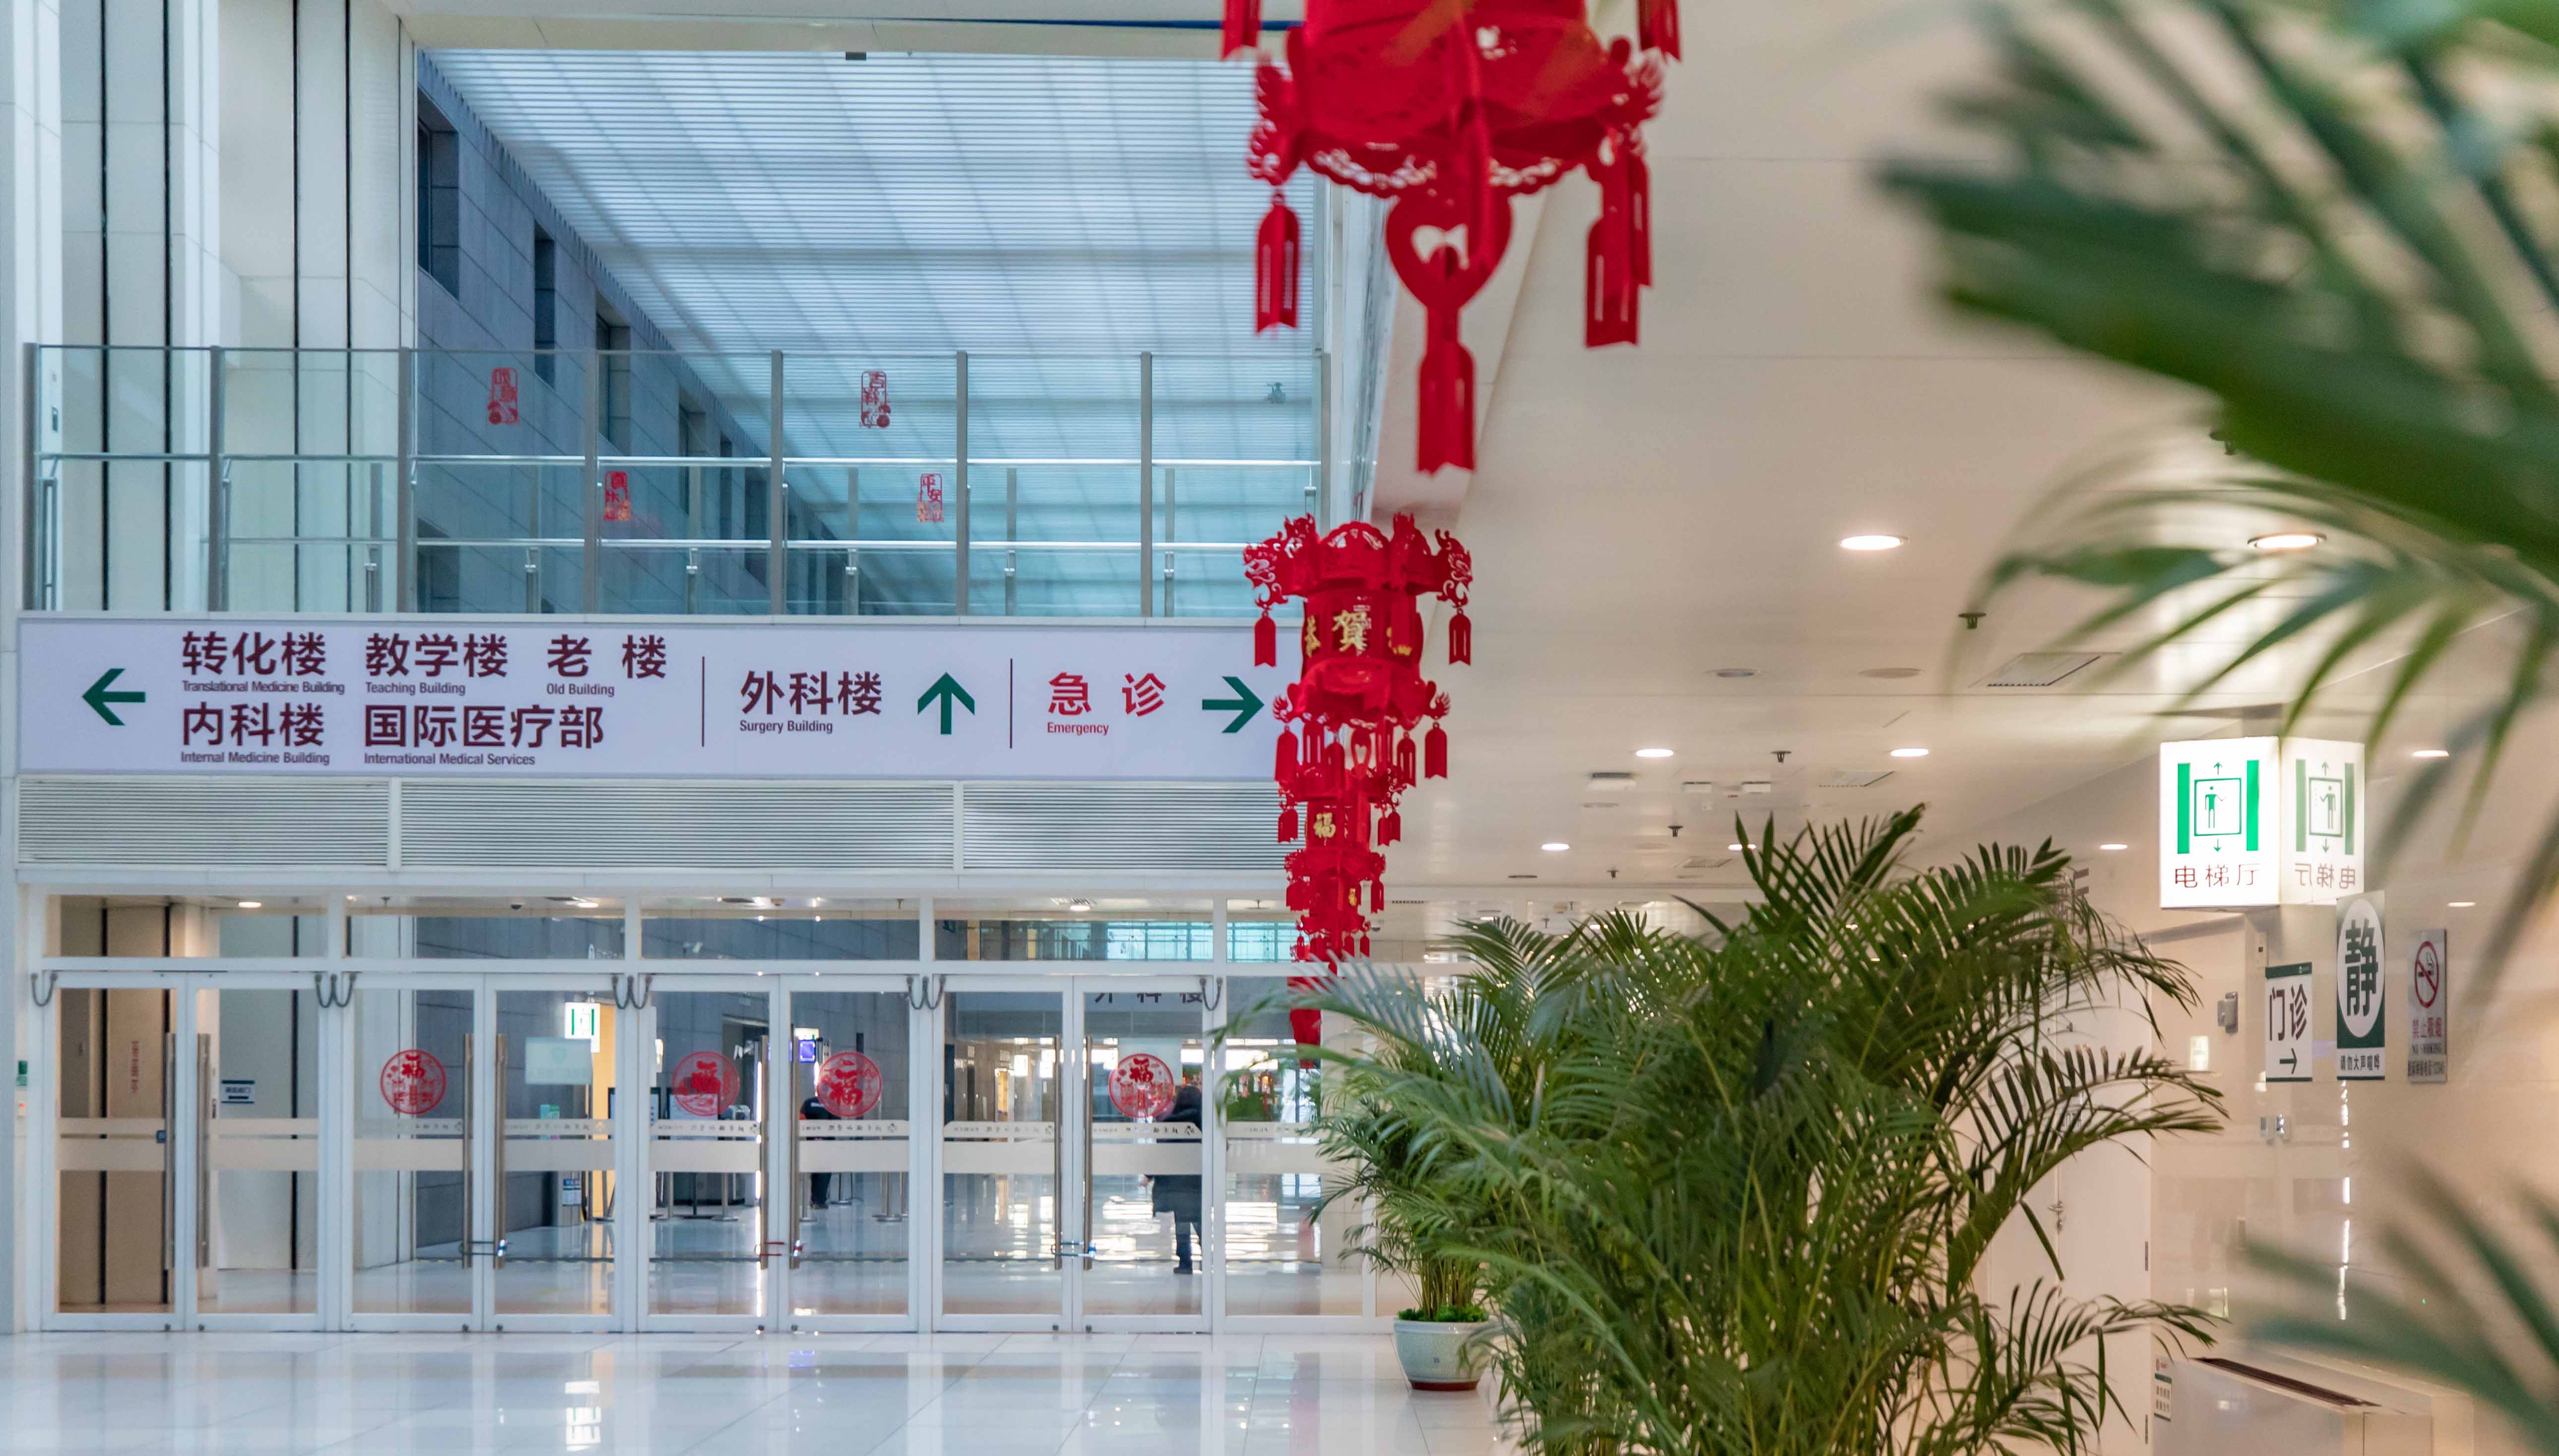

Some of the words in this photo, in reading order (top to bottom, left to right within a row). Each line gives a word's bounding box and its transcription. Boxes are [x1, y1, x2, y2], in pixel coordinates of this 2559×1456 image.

[182, 631, 326, 676] 转化楼
[366, 633, 508, 677] 教学楼
[547, 634, 666, 678] 老楼
[182, 680, 248, 692] Translational
[252, 681, 299, 692] Medicine
[302, 681, 345, 695] Building
[365, 681, 415, 696] Teaching
[419, 682, 465, 696] Building
[547, 683, 565, 695] Old
[569, 683, 615, 697] Building
[741, 671, 881, 715] 外科楼
[1048, 672, 1166, 717] 急诊
[183, 701, 324, 746] 内科楼
[365, 704, 603, 749] 国际医疗部
[740, 720, 783, 734] Surgery
[787, 720, 833, 734] Building
[1047, 722, 1109, 735] Emergency
[181, 751, 225, 763] Internal
[228, 751, 280, 763] Medicine
[283, 752, 330, 766] Building
[364, 753, 436, 764] International
[439, 753, 483, 765] Medical
[487, 753, 535, 765] Services
[2175, 864, 2261, 888] 电梯厅
[2345, 918, 2379, 1017] 静
[2269, 984, 2308, 1041] 门诊
[829, 1068, 864, 1106] 福
[1129, 1058, 1154, 1082] 福
